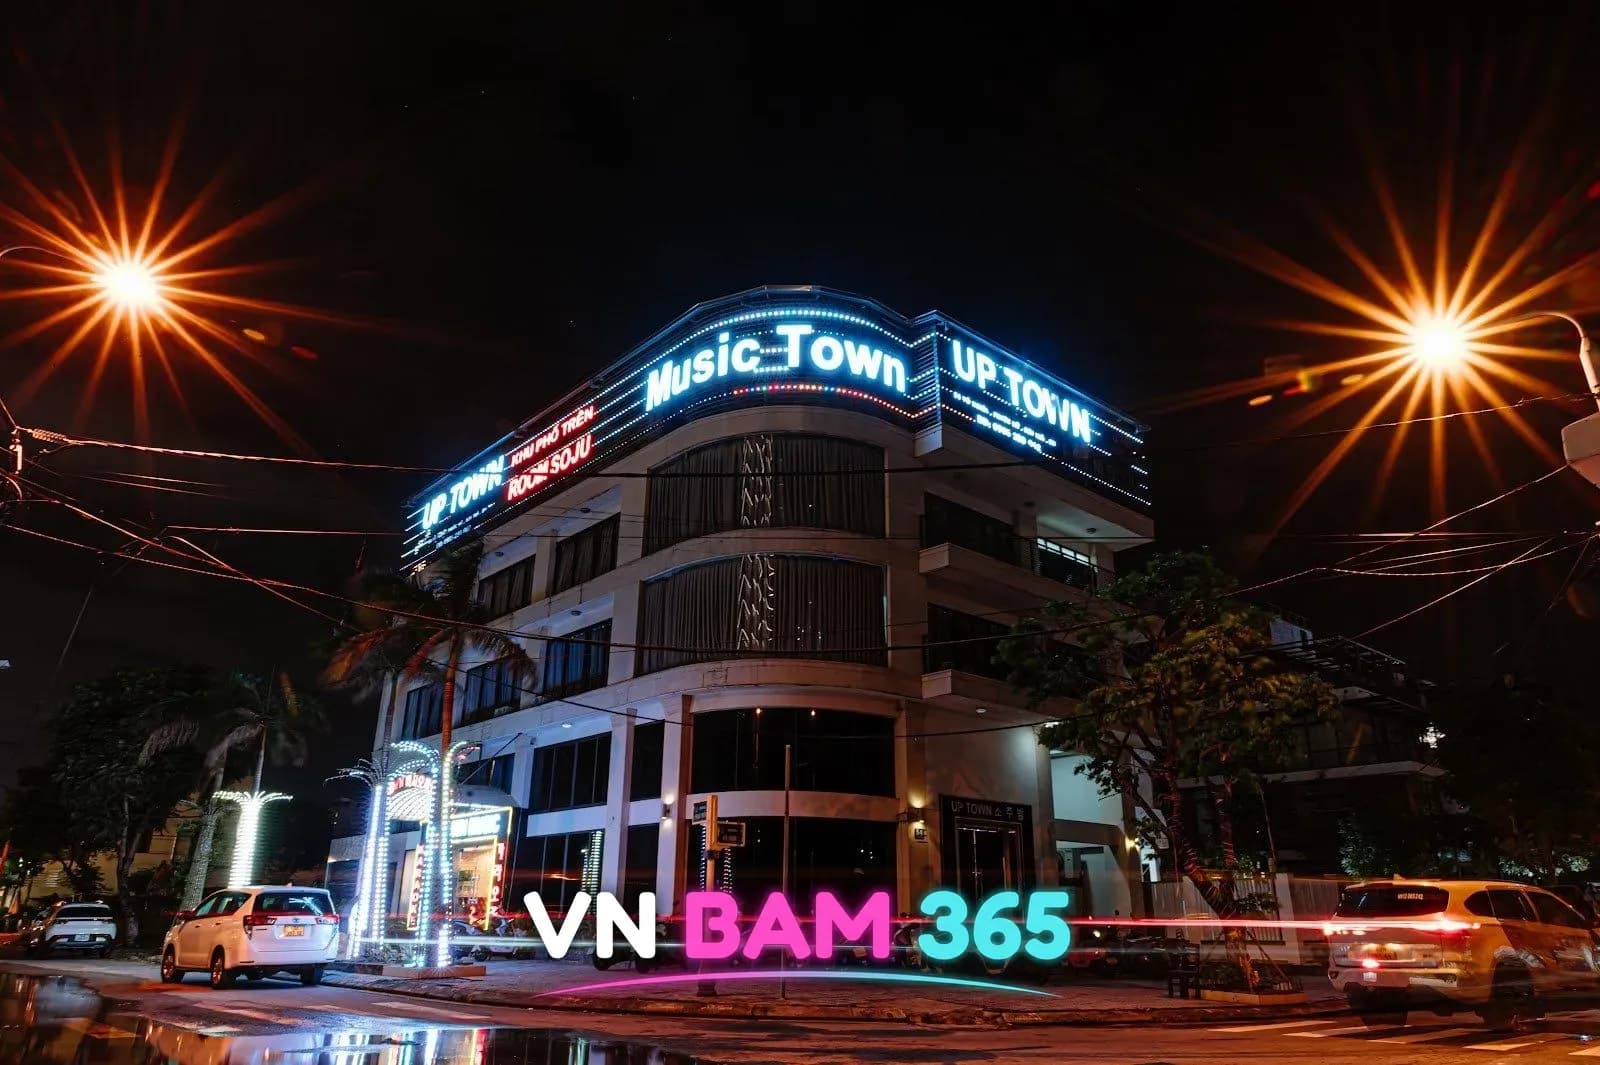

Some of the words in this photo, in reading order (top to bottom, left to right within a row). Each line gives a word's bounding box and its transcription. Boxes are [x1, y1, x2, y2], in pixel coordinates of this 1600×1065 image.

[645, 332, 761, 412] Music
[776, 324, 906, 392] Town
[952, 339, 997, 390] UP
[1003, 367, 1091, 443] TOWN
[507, 460, 549, 500] ROOM
[550, 434, 592, 474] SOJU
[511, 443, 535, 468] KHU
[561, 405, 594, 436] TRÊN
[422, 493, 448, 530] UP
[450, 455, 504, 514] TOWN
[951, 800, 964, 814] UP
[965, 802, 993, 818] TOWN
